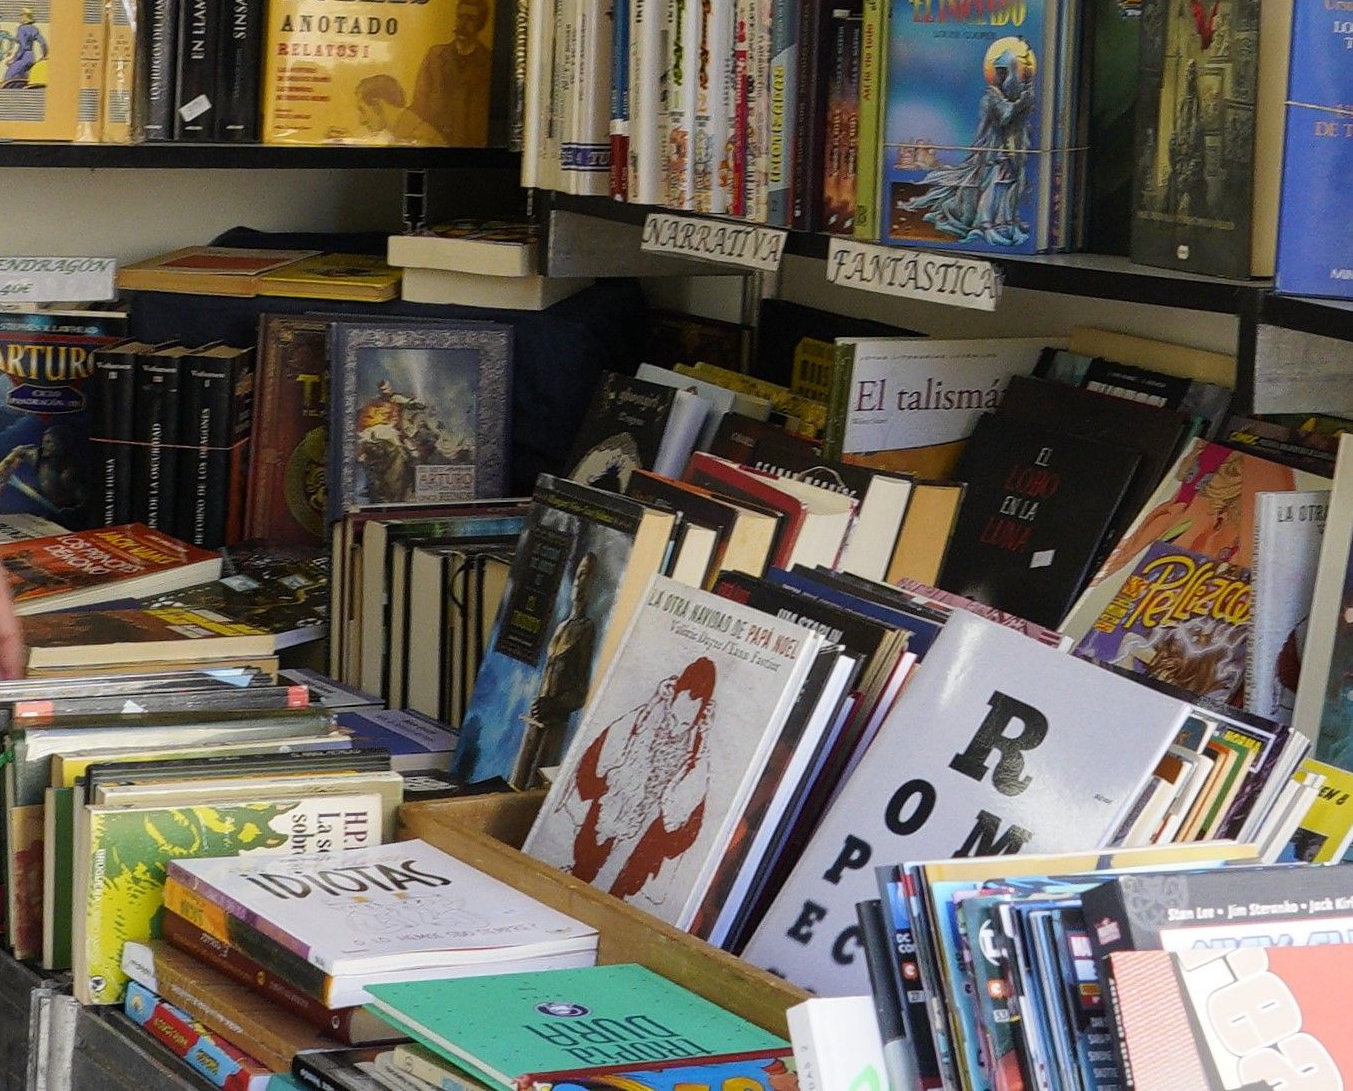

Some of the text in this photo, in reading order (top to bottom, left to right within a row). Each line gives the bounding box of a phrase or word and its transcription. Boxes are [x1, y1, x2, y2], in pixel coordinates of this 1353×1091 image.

[280, 15, 399, 35] ANOTADO
[191, 39, 206, 59] EN
[277, 42, 359, 59] RELATOS
[641, 216, 782, 263] NARRATIVA
[827, 246, 997, 299] FANTÁSTICA
[856, 380, 886, 413] El
[150, 423, 161, 479] OSCURIDAD
[1035, 447, 1054, 467] EL
[149, 481, 159, 494] LA
[1004, 464, 1062, 499] LOBO
[999, 495, 1041, 522] EN LA
[97, 531, 131, 549] JACK
[979, 516, 1035, 552] LUNA
[647, 589, 664, 607] LA
[663, 593, 687, 617] OTRA
[689, 602, 734, 634] NAVIDAD
[730, 617, 749, 641] DE
[744, 624, 776, 653] PAPÁ
[772, 633, 800, 660] NOEL
[948, 690, 1049, 797] R
[316, 812, 341, 835] La
[1168, 897, 1333, 921] Stan Lee Jim Steranko Jack
[522, 1014, 683, 1048] DURA
